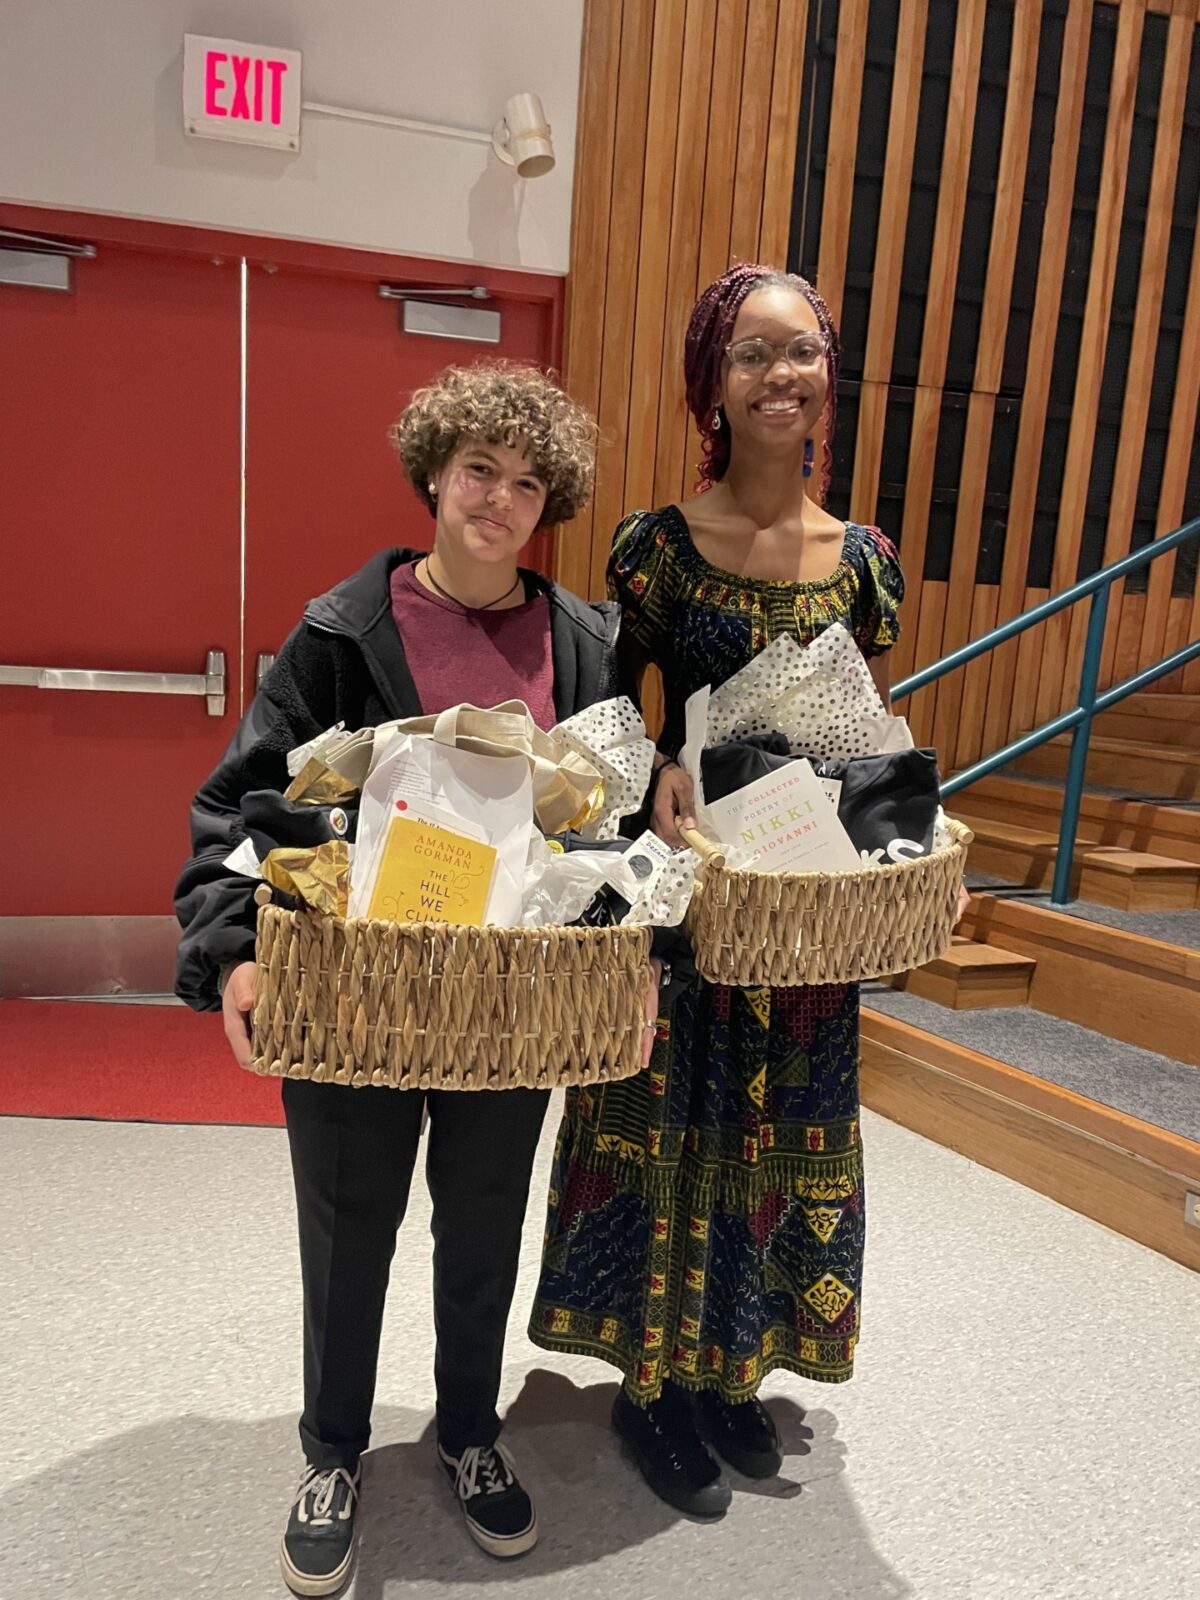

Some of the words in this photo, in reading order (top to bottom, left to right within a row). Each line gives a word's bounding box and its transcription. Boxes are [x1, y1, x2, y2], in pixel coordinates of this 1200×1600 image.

[206, 51, 287, 125] EXIT
[726, 803, 745, 815] THE
[748, 777, 800, 805] COLLECTED
[739, 800, 814, 844] NIKKI
[744, 800, 779, 821] POETRY
[414, 844, 471, 870] GORMAN
[416, 834, 472, 860] AMANDA
[419, 879, 451, 898] HILL
[429, 870, 449, 882] THE
[420, 895, 444, 912] WE
